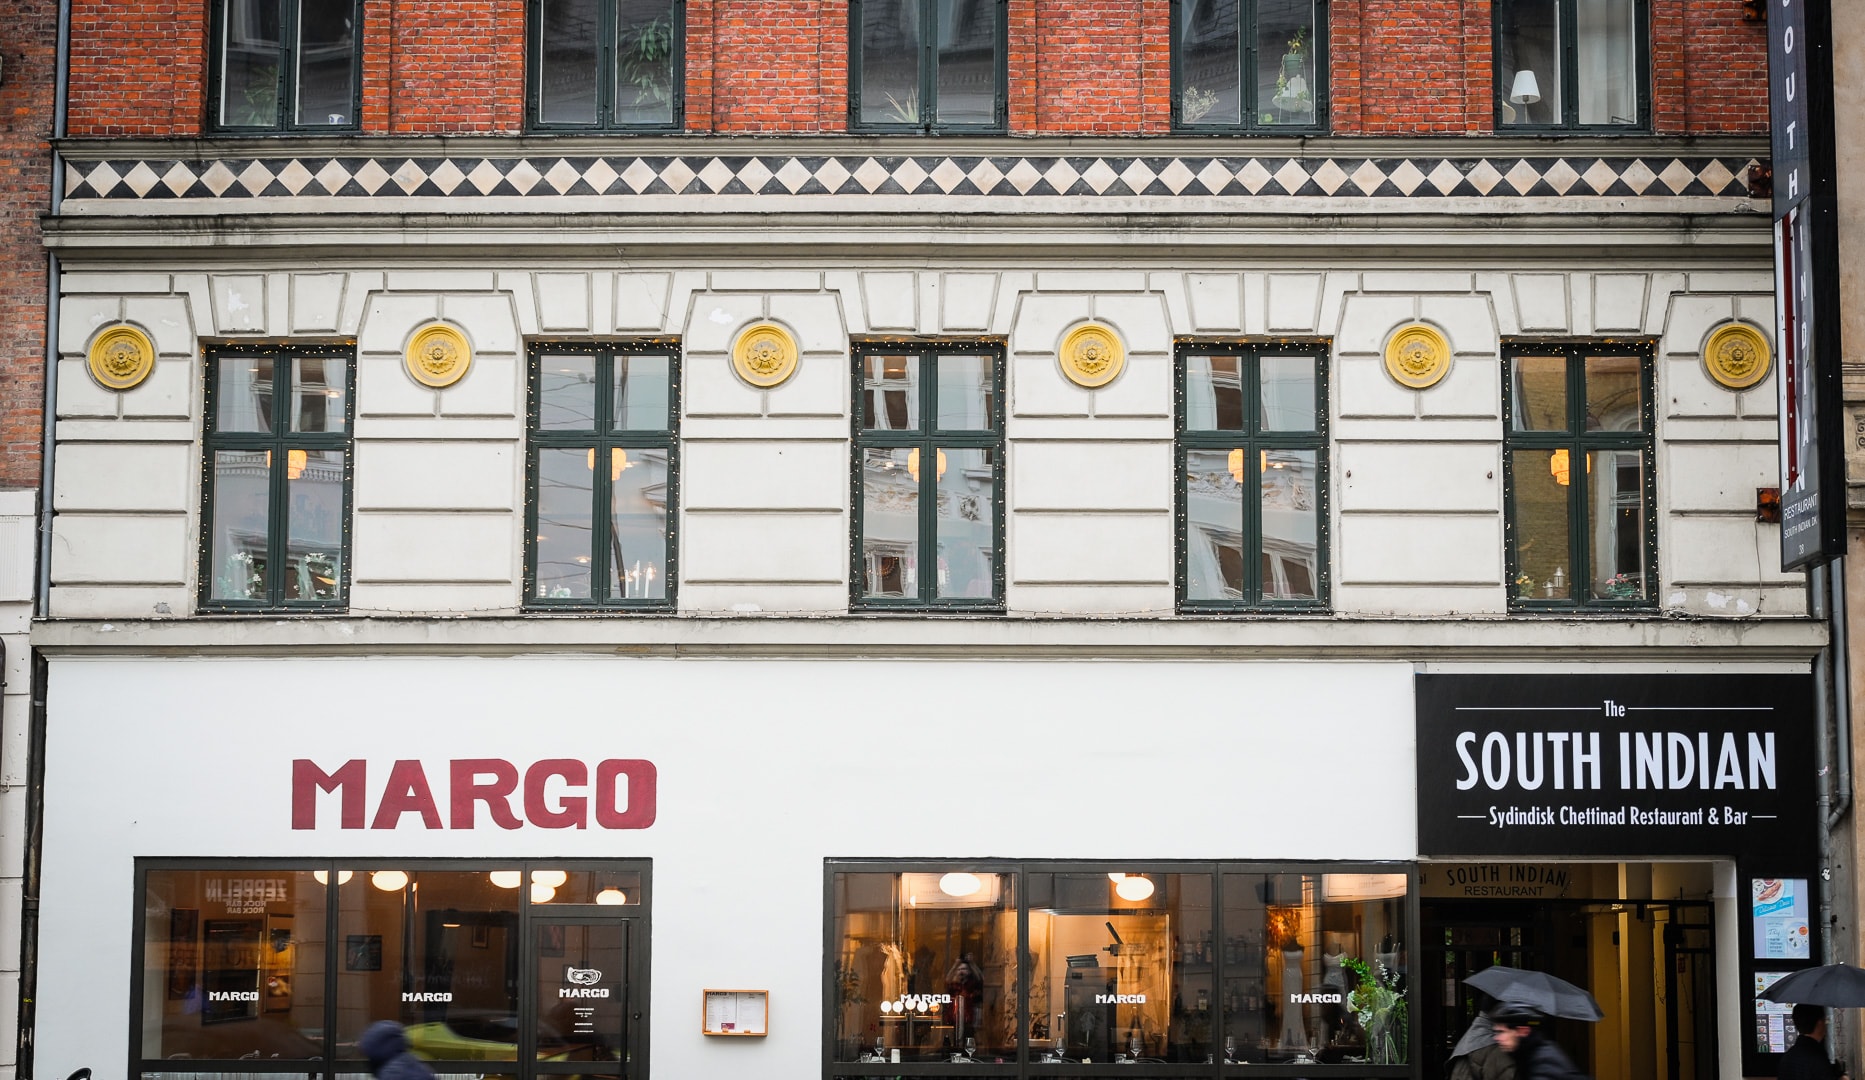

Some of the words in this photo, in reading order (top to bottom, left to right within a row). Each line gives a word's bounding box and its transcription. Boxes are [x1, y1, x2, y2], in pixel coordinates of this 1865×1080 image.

[1782, 0, 1798, 200] OUTH
[1783, 493, 1818, 520] RESTAURANT
[1603, 700, 1626, 717] The
[1455, 731, 1601, 791] SOUTH
[1619, 731, 1777, 790] INDIAN
[292, 758, 657, 830] MARGO
[1489, 805, 1556, 829] Sydindisk
[1559, 805, 1626, 826] Chettinad
[1630, 806, 1703, 826] Restaurant
[1707, 807, 1720, 826] &
[1724, 806, 1748, 826] Bar
[1447, 865, 1500, 886] SOUTH
[1509, 865, 1567, 887] INDIAN
[1464, 886, 1544, 897] RESTAURANT
[208, 991, 260, 1002] MARGO
[401, 992, 453, 1002] MARGO
[558, 988, 610, 998] MARGO
[900, 993, 952, 1004] MARGO
[1095, 994, 1146, 1004] MARGO
[1290, 993, 1342, 1004] MARGO
